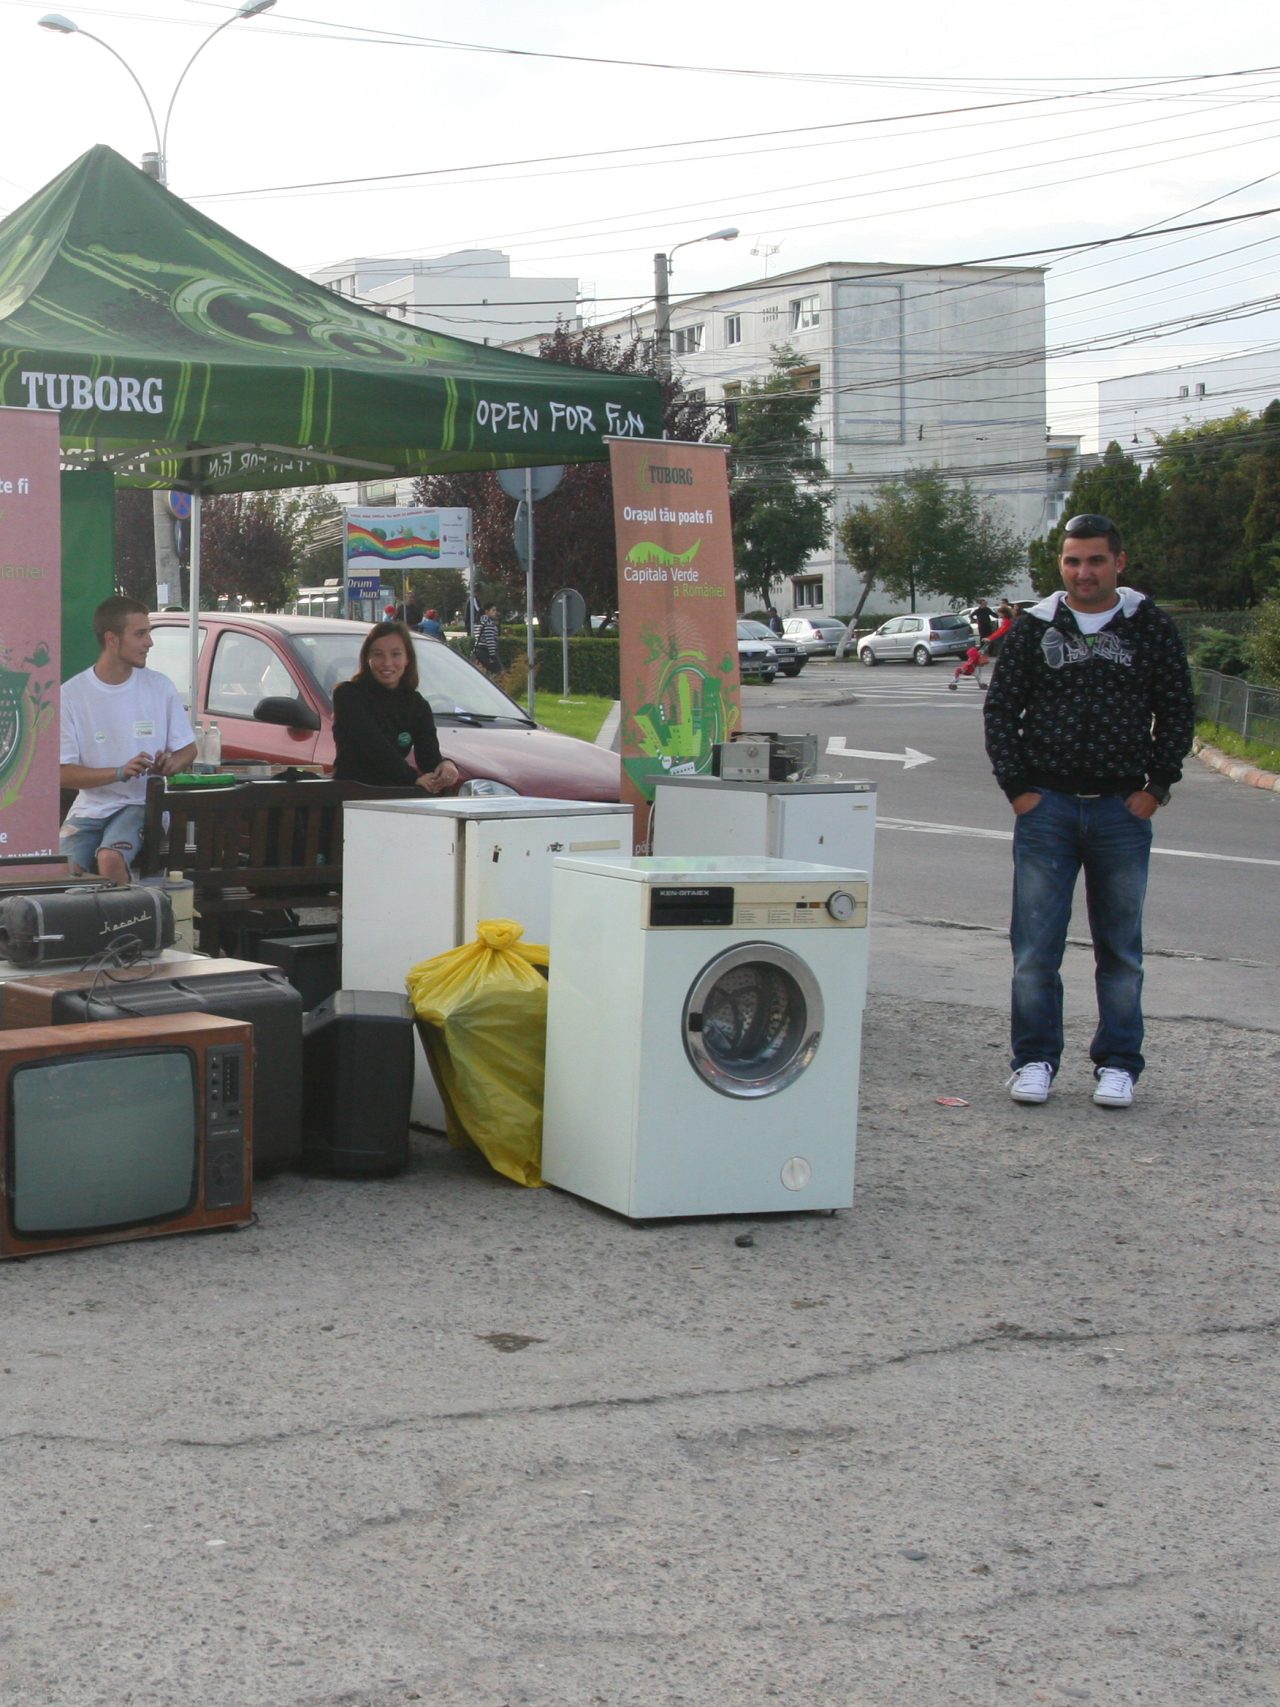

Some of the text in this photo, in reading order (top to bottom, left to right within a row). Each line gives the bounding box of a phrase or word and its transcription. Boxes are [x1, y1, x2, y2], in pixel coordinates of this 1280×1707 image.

[21, 371, 163, 414] TUBORG
[476, 398, 645, 436] OPEN FOR FUN
[649, 465, 693, 486] TUBORG
[17, 478, 29, 495] fi
[659, 508, 676, 522] tău
[679, 511, 704, 525] poate
[705, 510, 713, 524] fi
[624, 567, 700, 584] Capitala Verde
[673, 585, 679, 596] a
